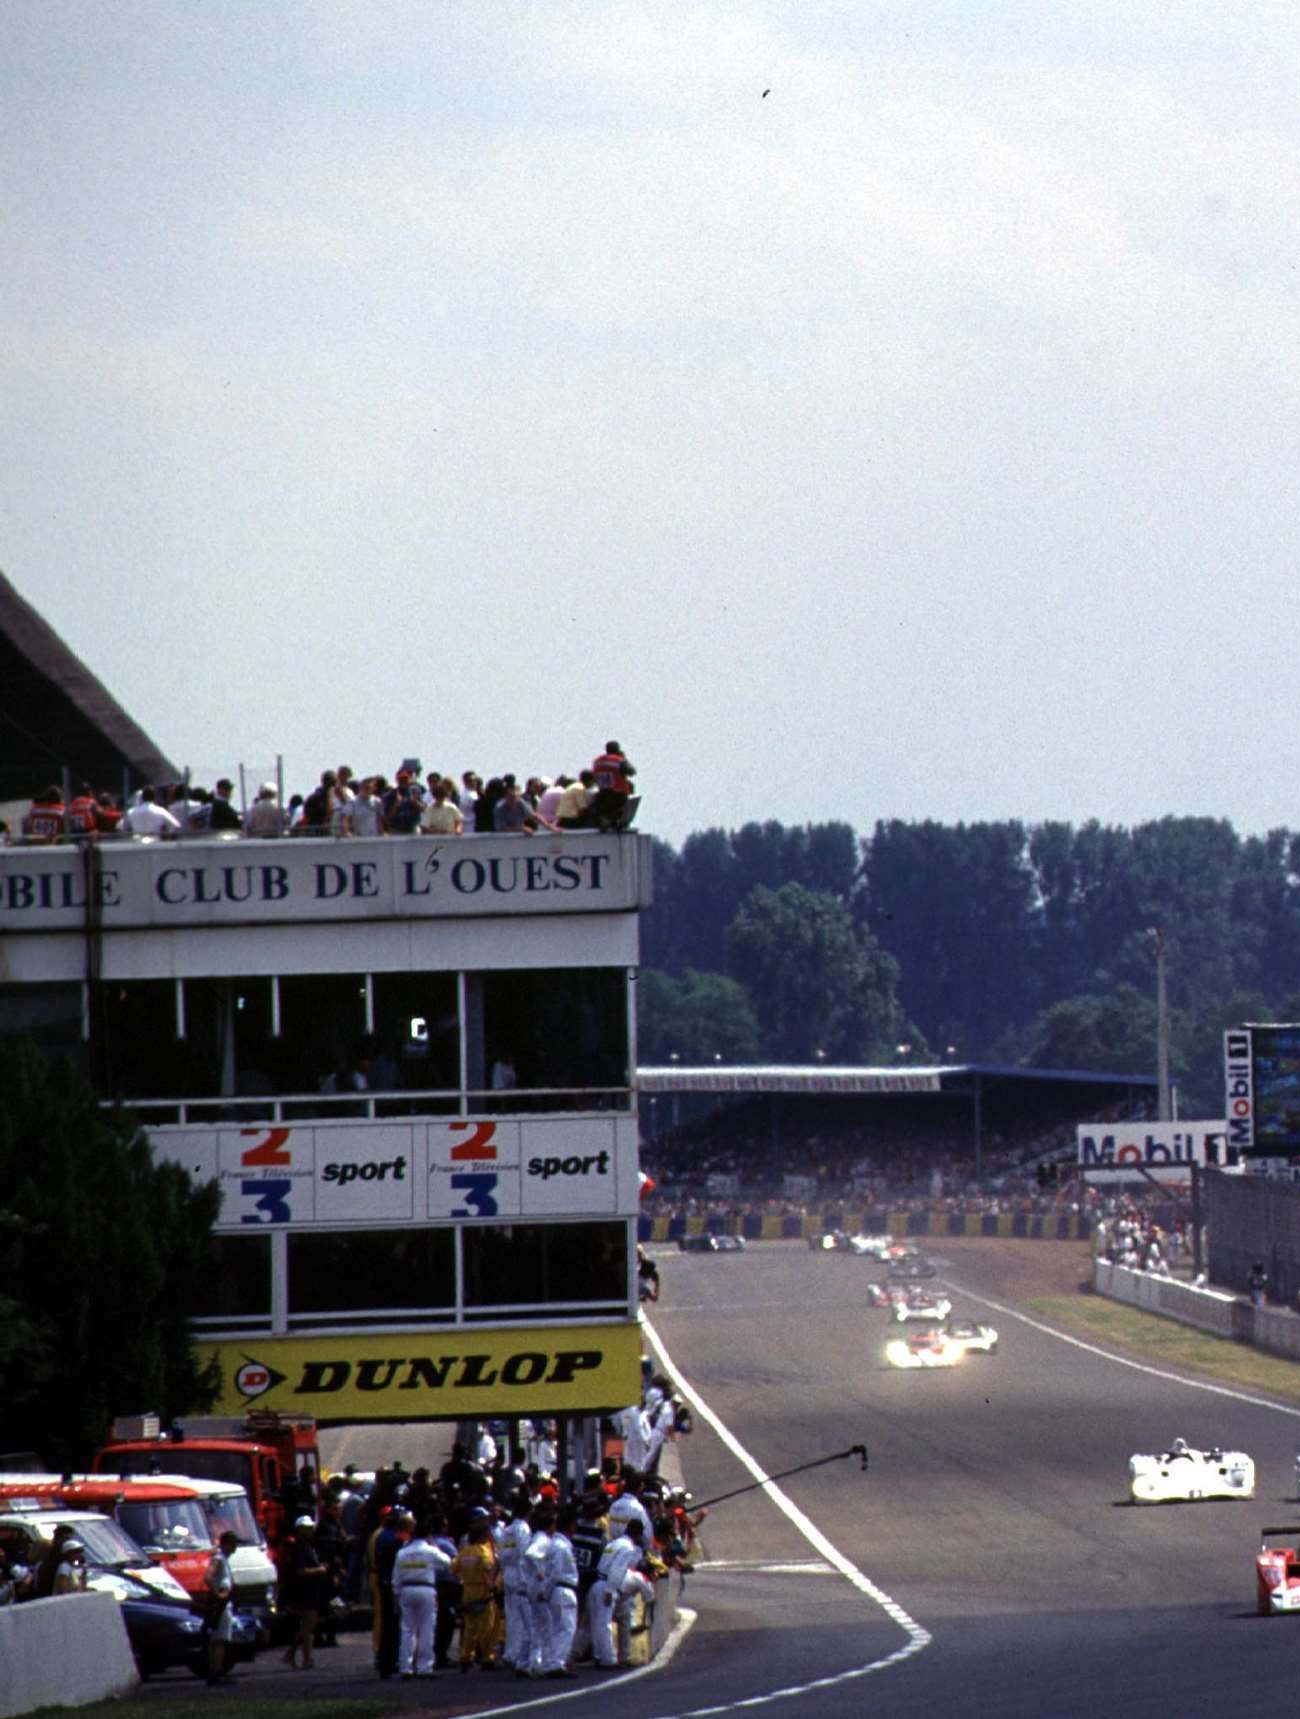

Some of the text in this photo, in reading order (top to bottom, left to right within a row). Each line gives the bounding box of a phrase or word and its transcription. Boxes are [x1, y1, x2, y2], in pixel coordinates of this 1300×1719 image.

[0, 870, 121, 909] BILE
[155, 865, 290, 904] CLUB
[313, 861, 379, 899] DE
[1228, 1064, 1250, 1144] Mobil
[240, 1128, 291, 1166] 2
[448, 1121, 497, 1160] 2
[1081, 1135, 1193, 1164] Mobil
[321, 1156, 407, 1186] sport
[528, 1150, 609, 1180] sport
[241, 1180, 291, 1223] 3
[450, 1173, 498, 1217] 3
[294, 1351, 603, 1394] DUNLOP
